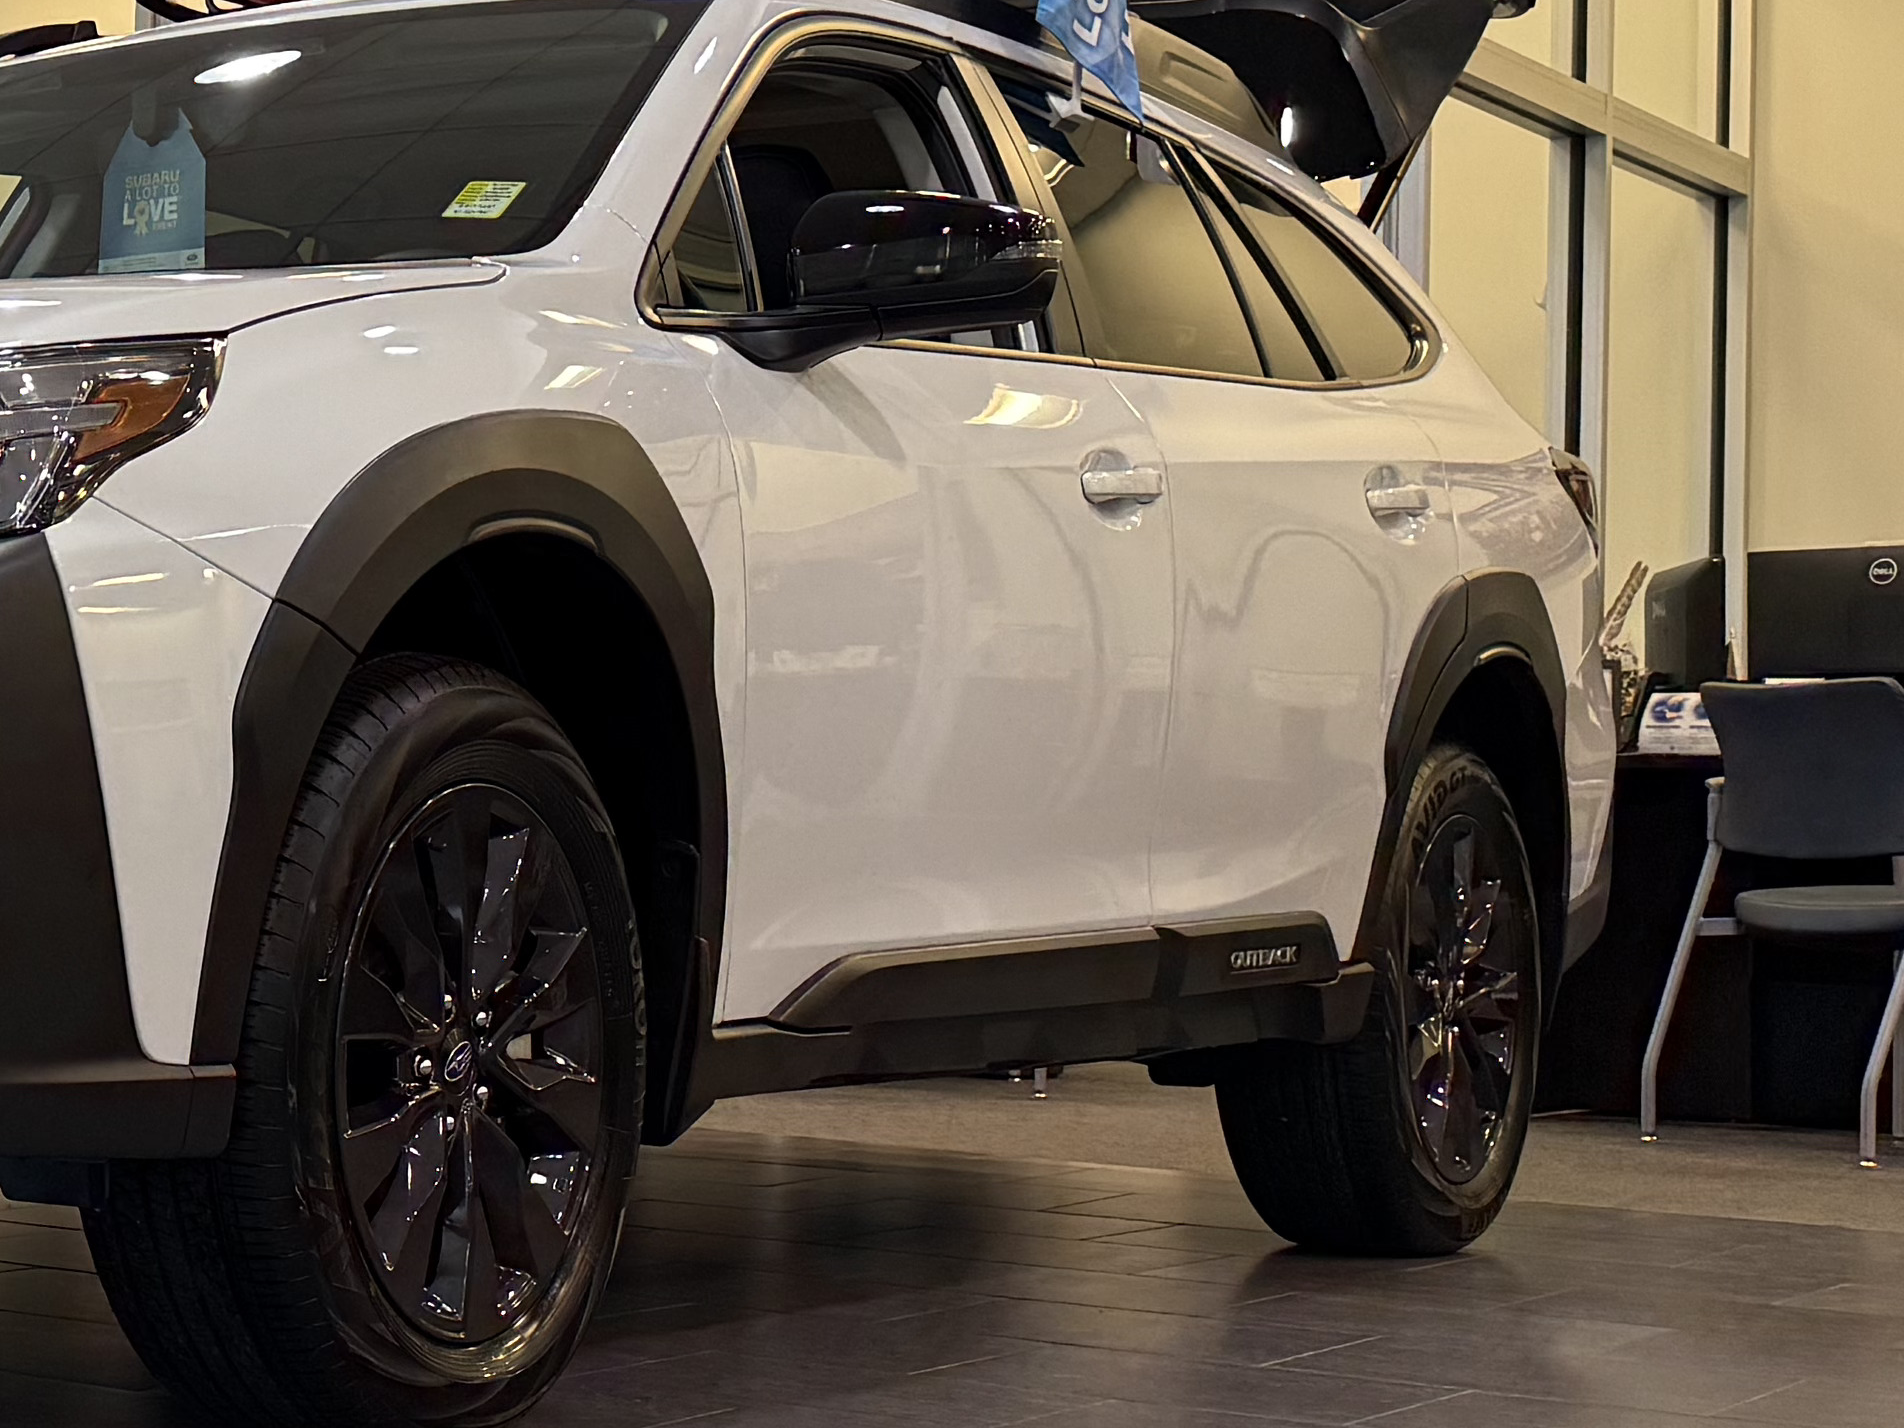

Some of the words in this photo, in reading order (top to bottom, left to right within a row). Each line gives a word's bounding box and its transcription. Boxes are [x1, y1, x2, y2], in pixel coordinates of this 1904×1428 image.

[125, 169, 180, 189] SUBARU
[136, 185, 159, 201] LOT
[163, 182, 180, 196] TO
[123, 196, 178, 229] LOVE
